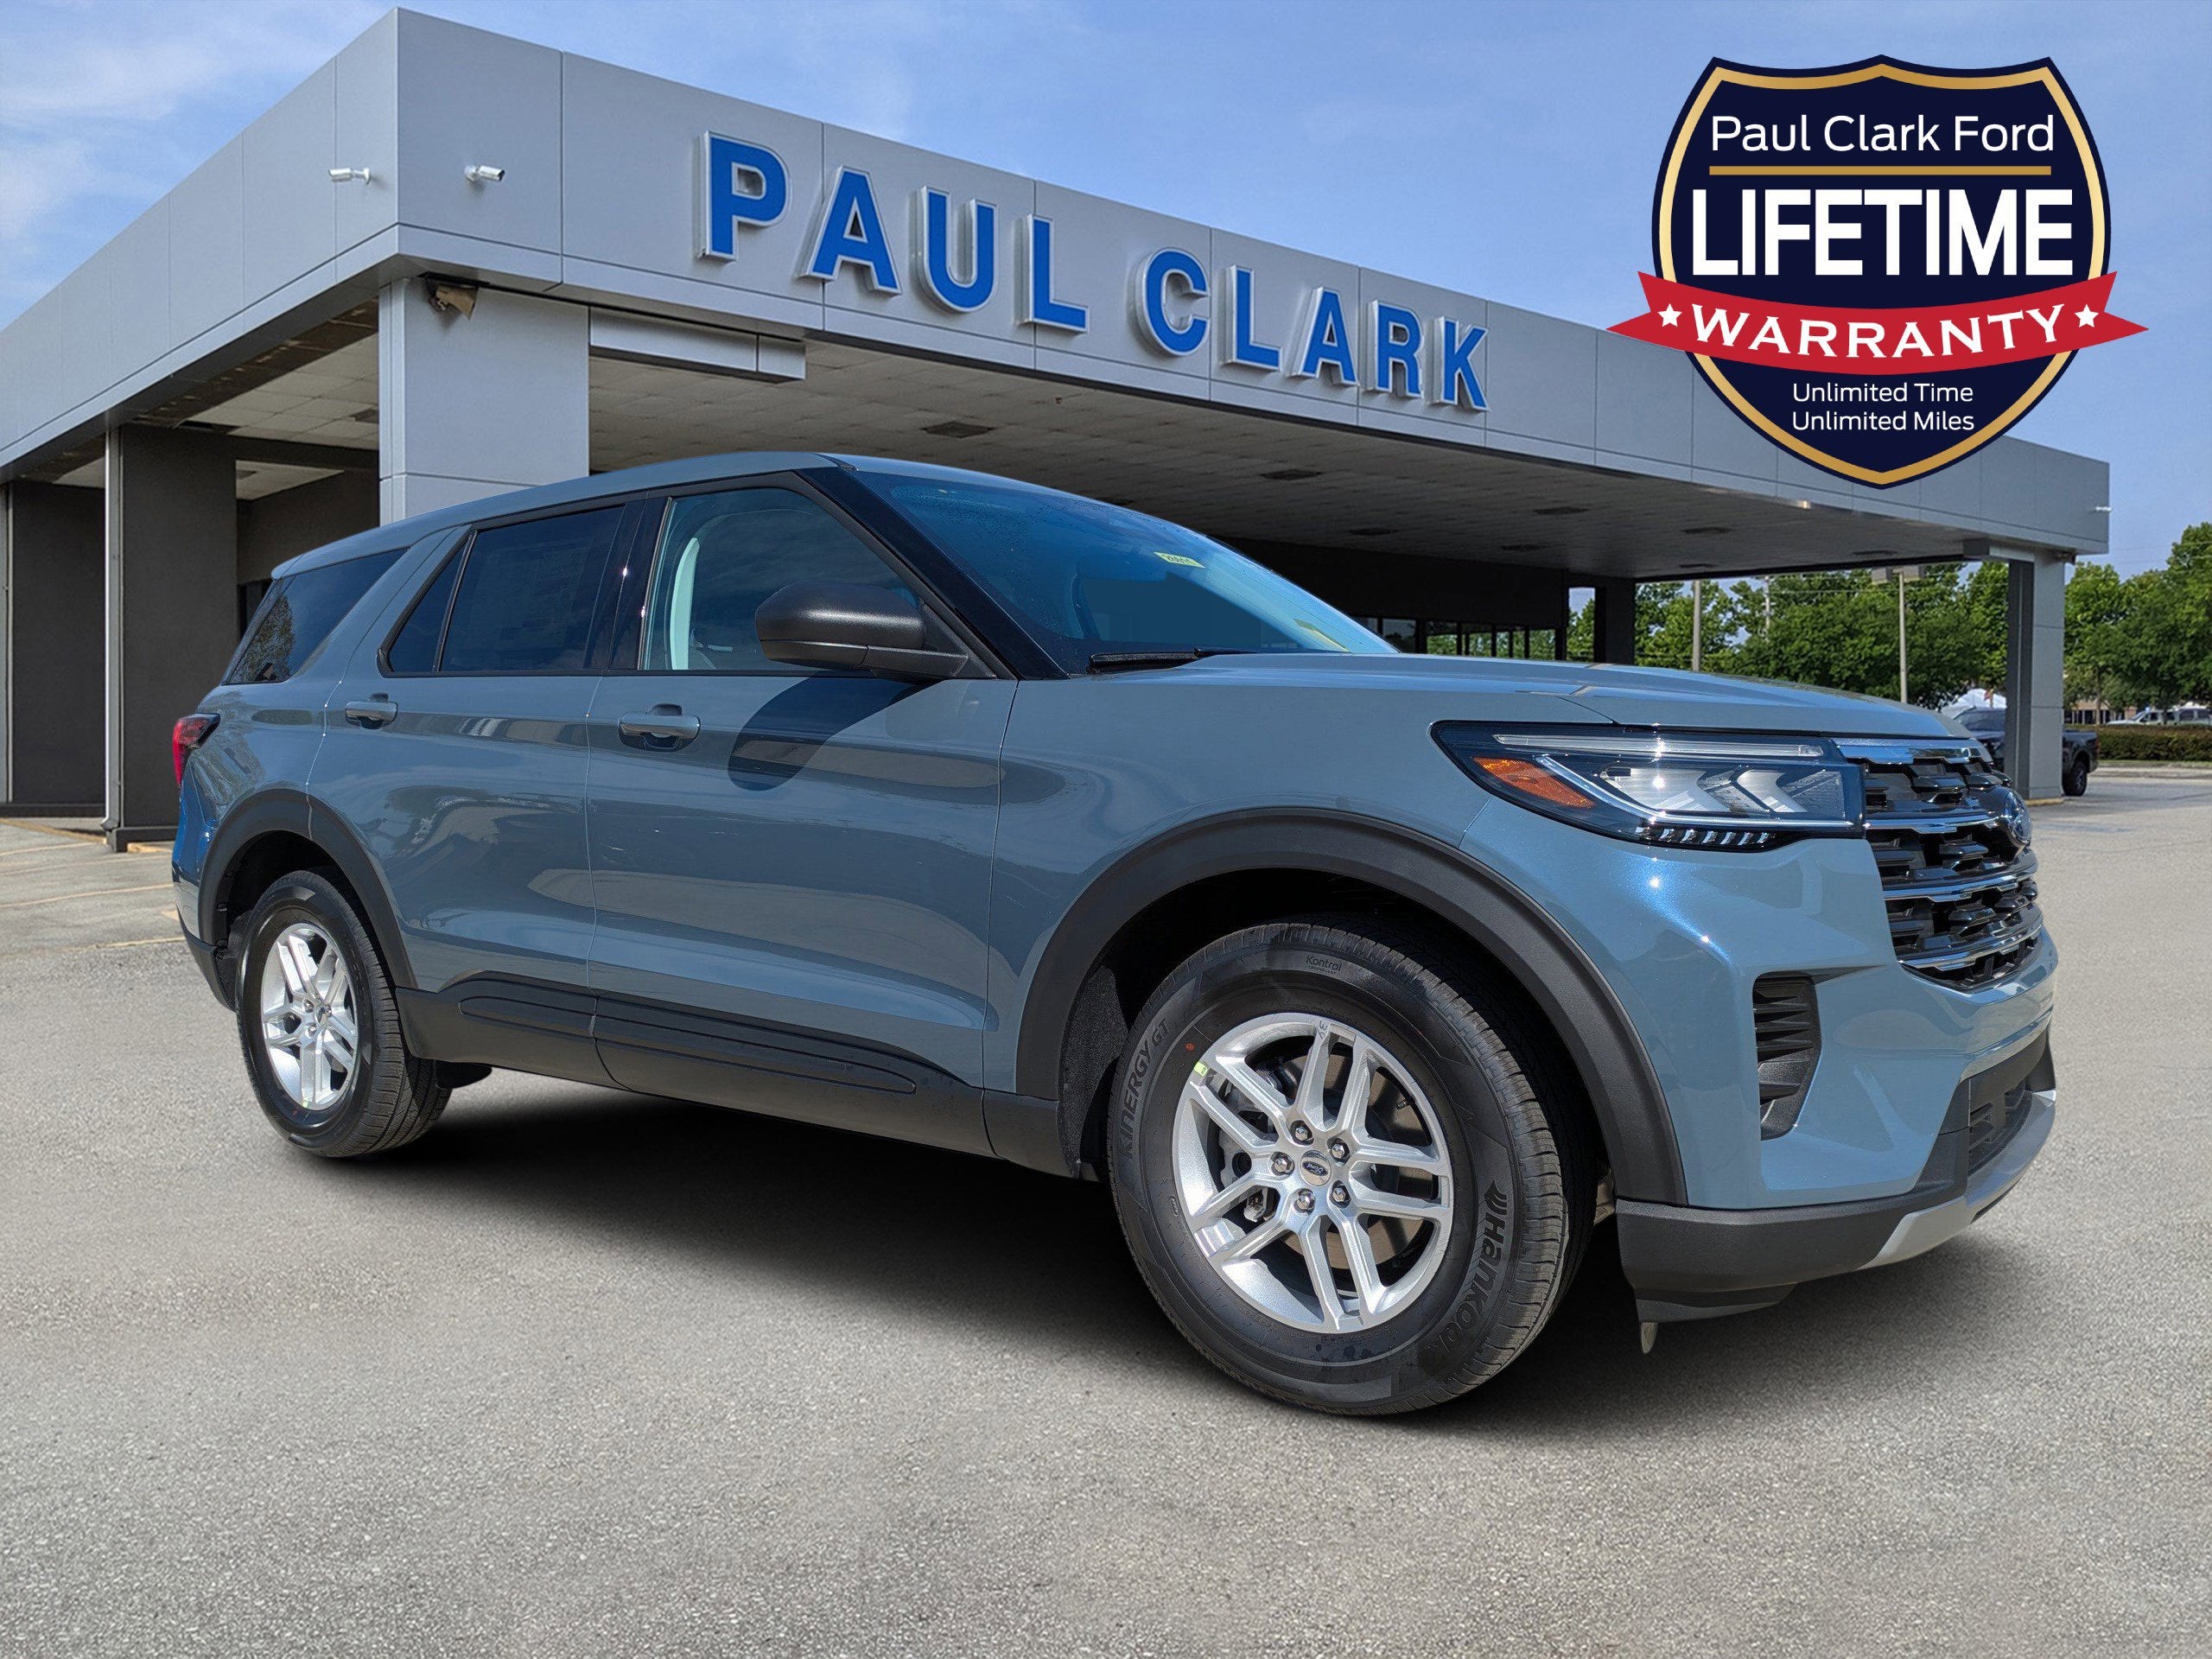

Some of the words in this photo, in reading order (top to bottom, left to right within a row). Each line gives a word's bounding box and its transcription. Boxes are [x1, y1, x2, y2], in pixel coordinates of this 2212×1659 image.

[705, 133, 1089, 332] PAUL
[1142, 247, 1488, 410] CLARK
[1306, 954, 1343, 971] Kontrol
